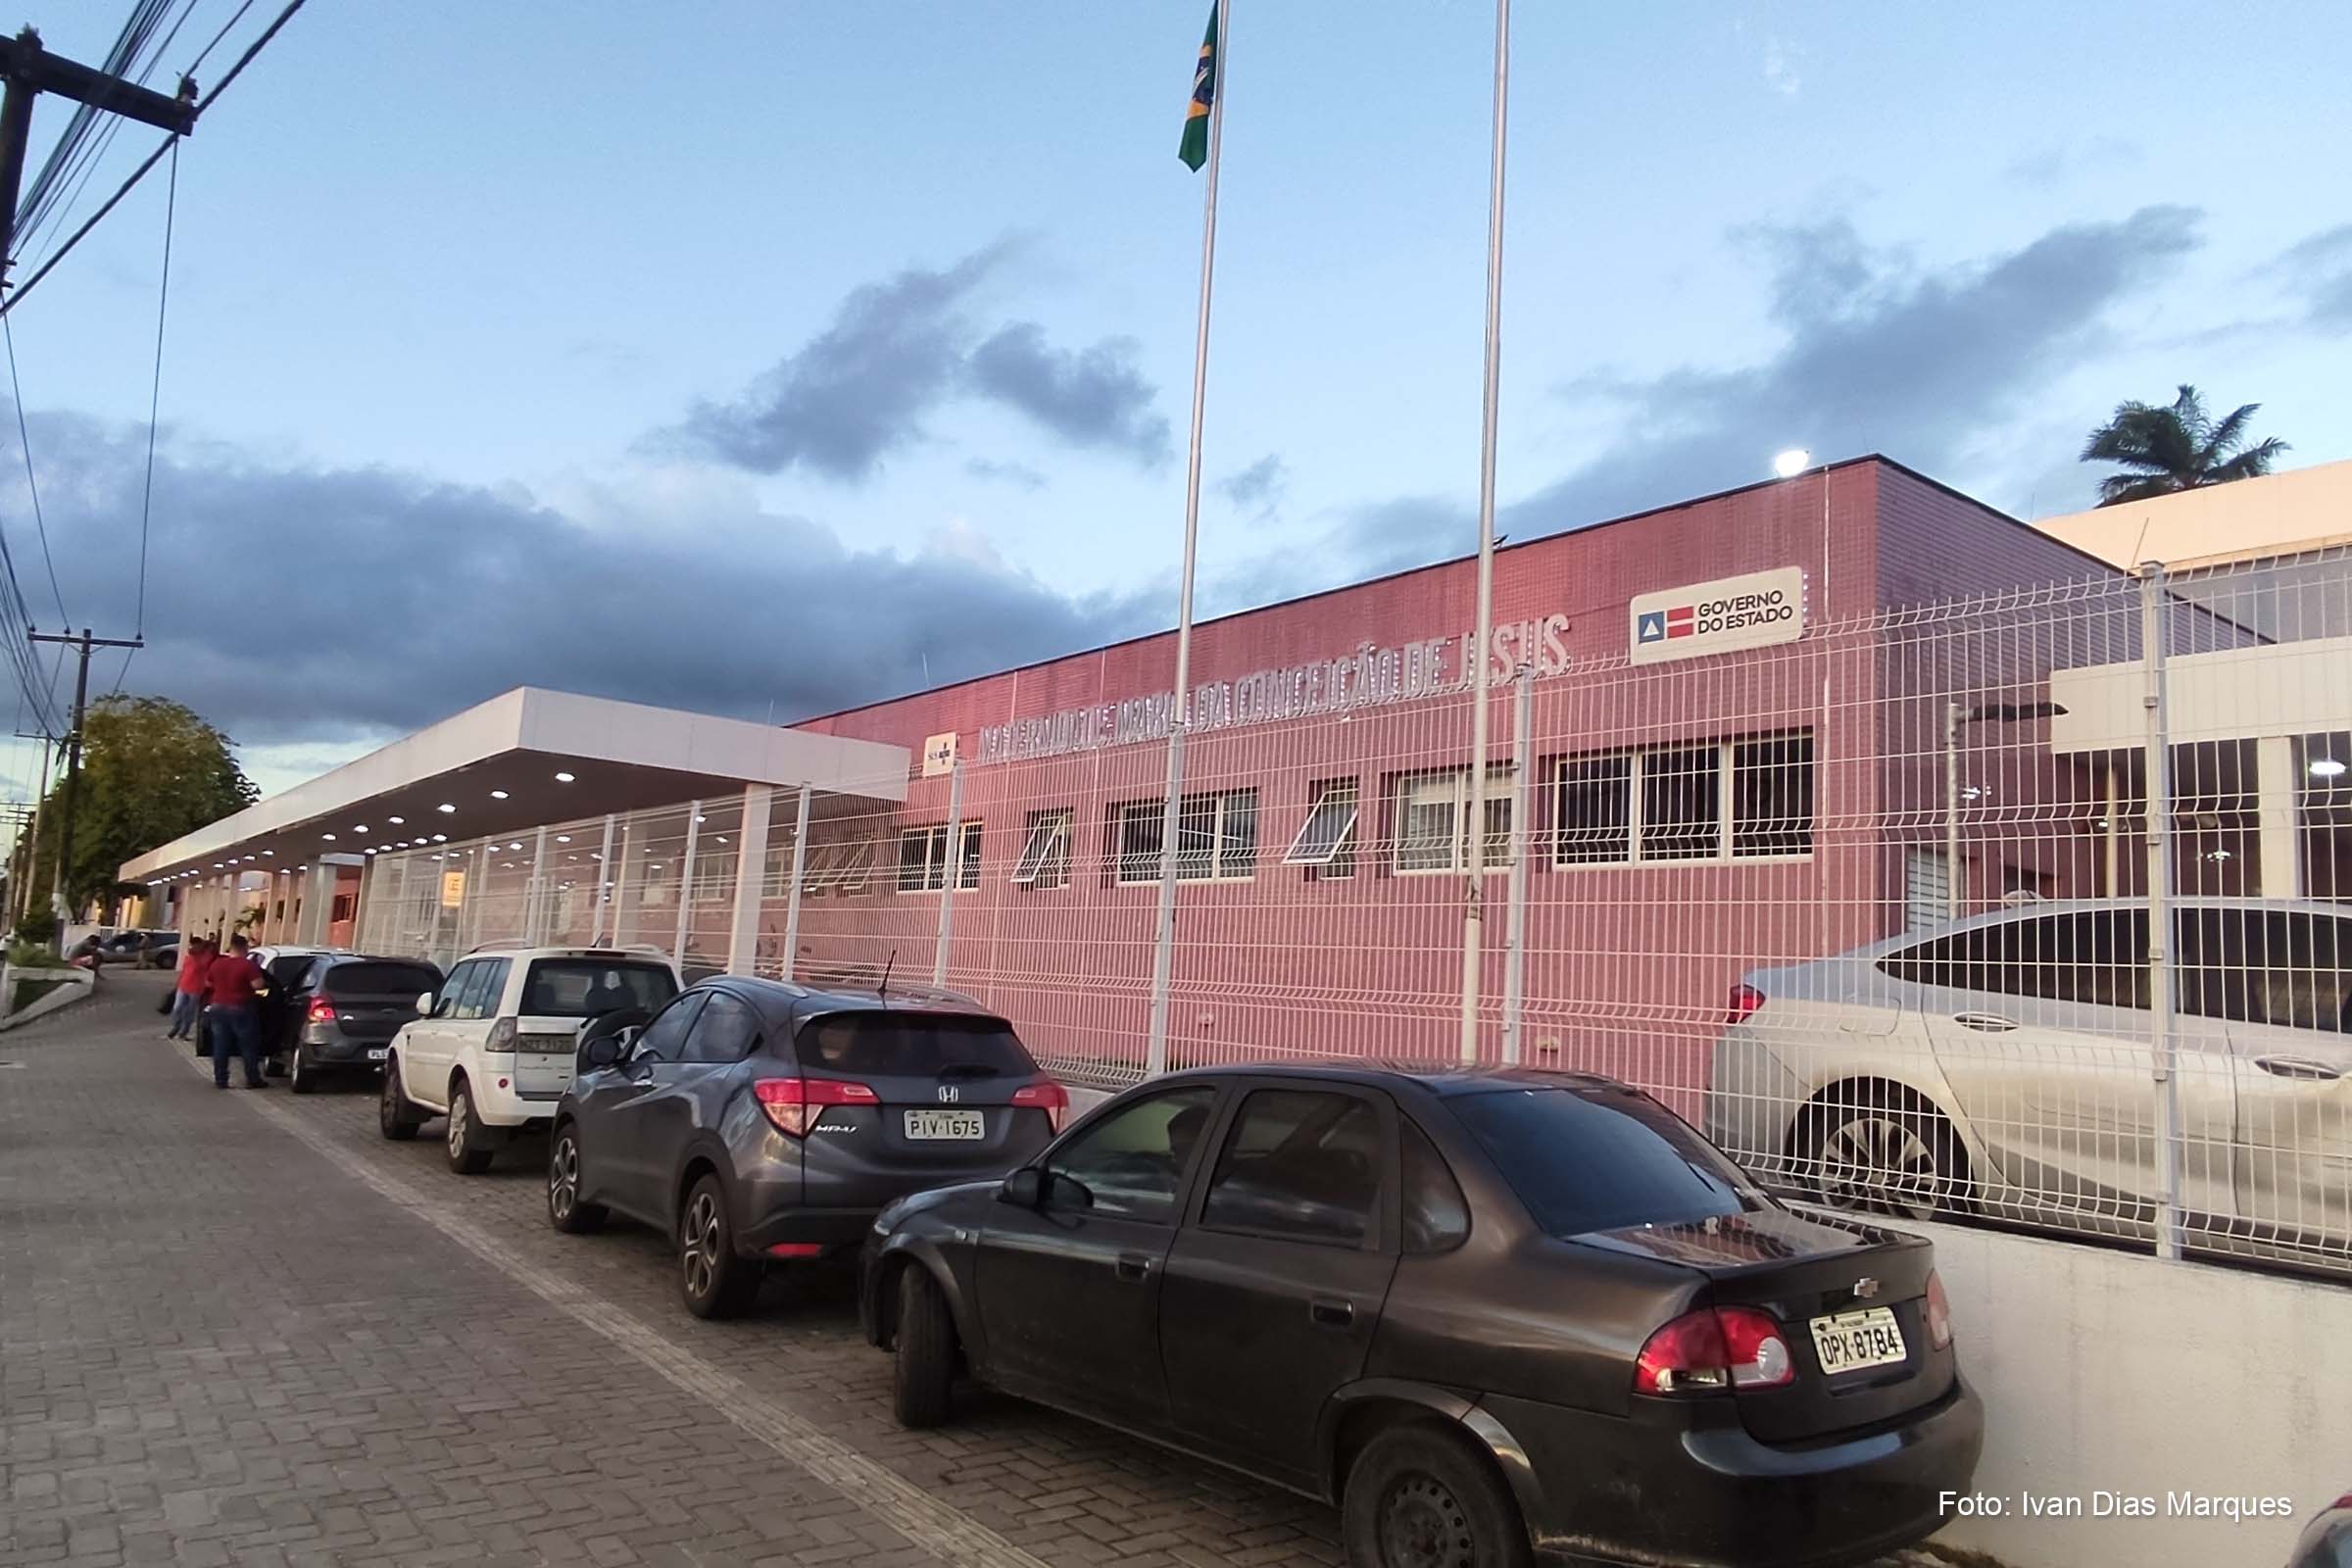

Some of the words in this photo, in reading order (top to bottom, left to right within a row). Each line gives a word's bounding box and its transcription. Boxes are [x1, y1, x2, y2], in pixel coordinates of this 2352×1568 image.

[1698, 590, 1783, 617] GOVERNO
[1698, 618, 1723, 634] DO
[1726, 606, 1793, 629] ESTADO
[1115, 688, 1188, 745] MARI
[1195, 680, 1228, 731] DA
[1232, 641, 1394, 723] CONCEIÇÃO
[1403, 637, 1447, 696] DE
